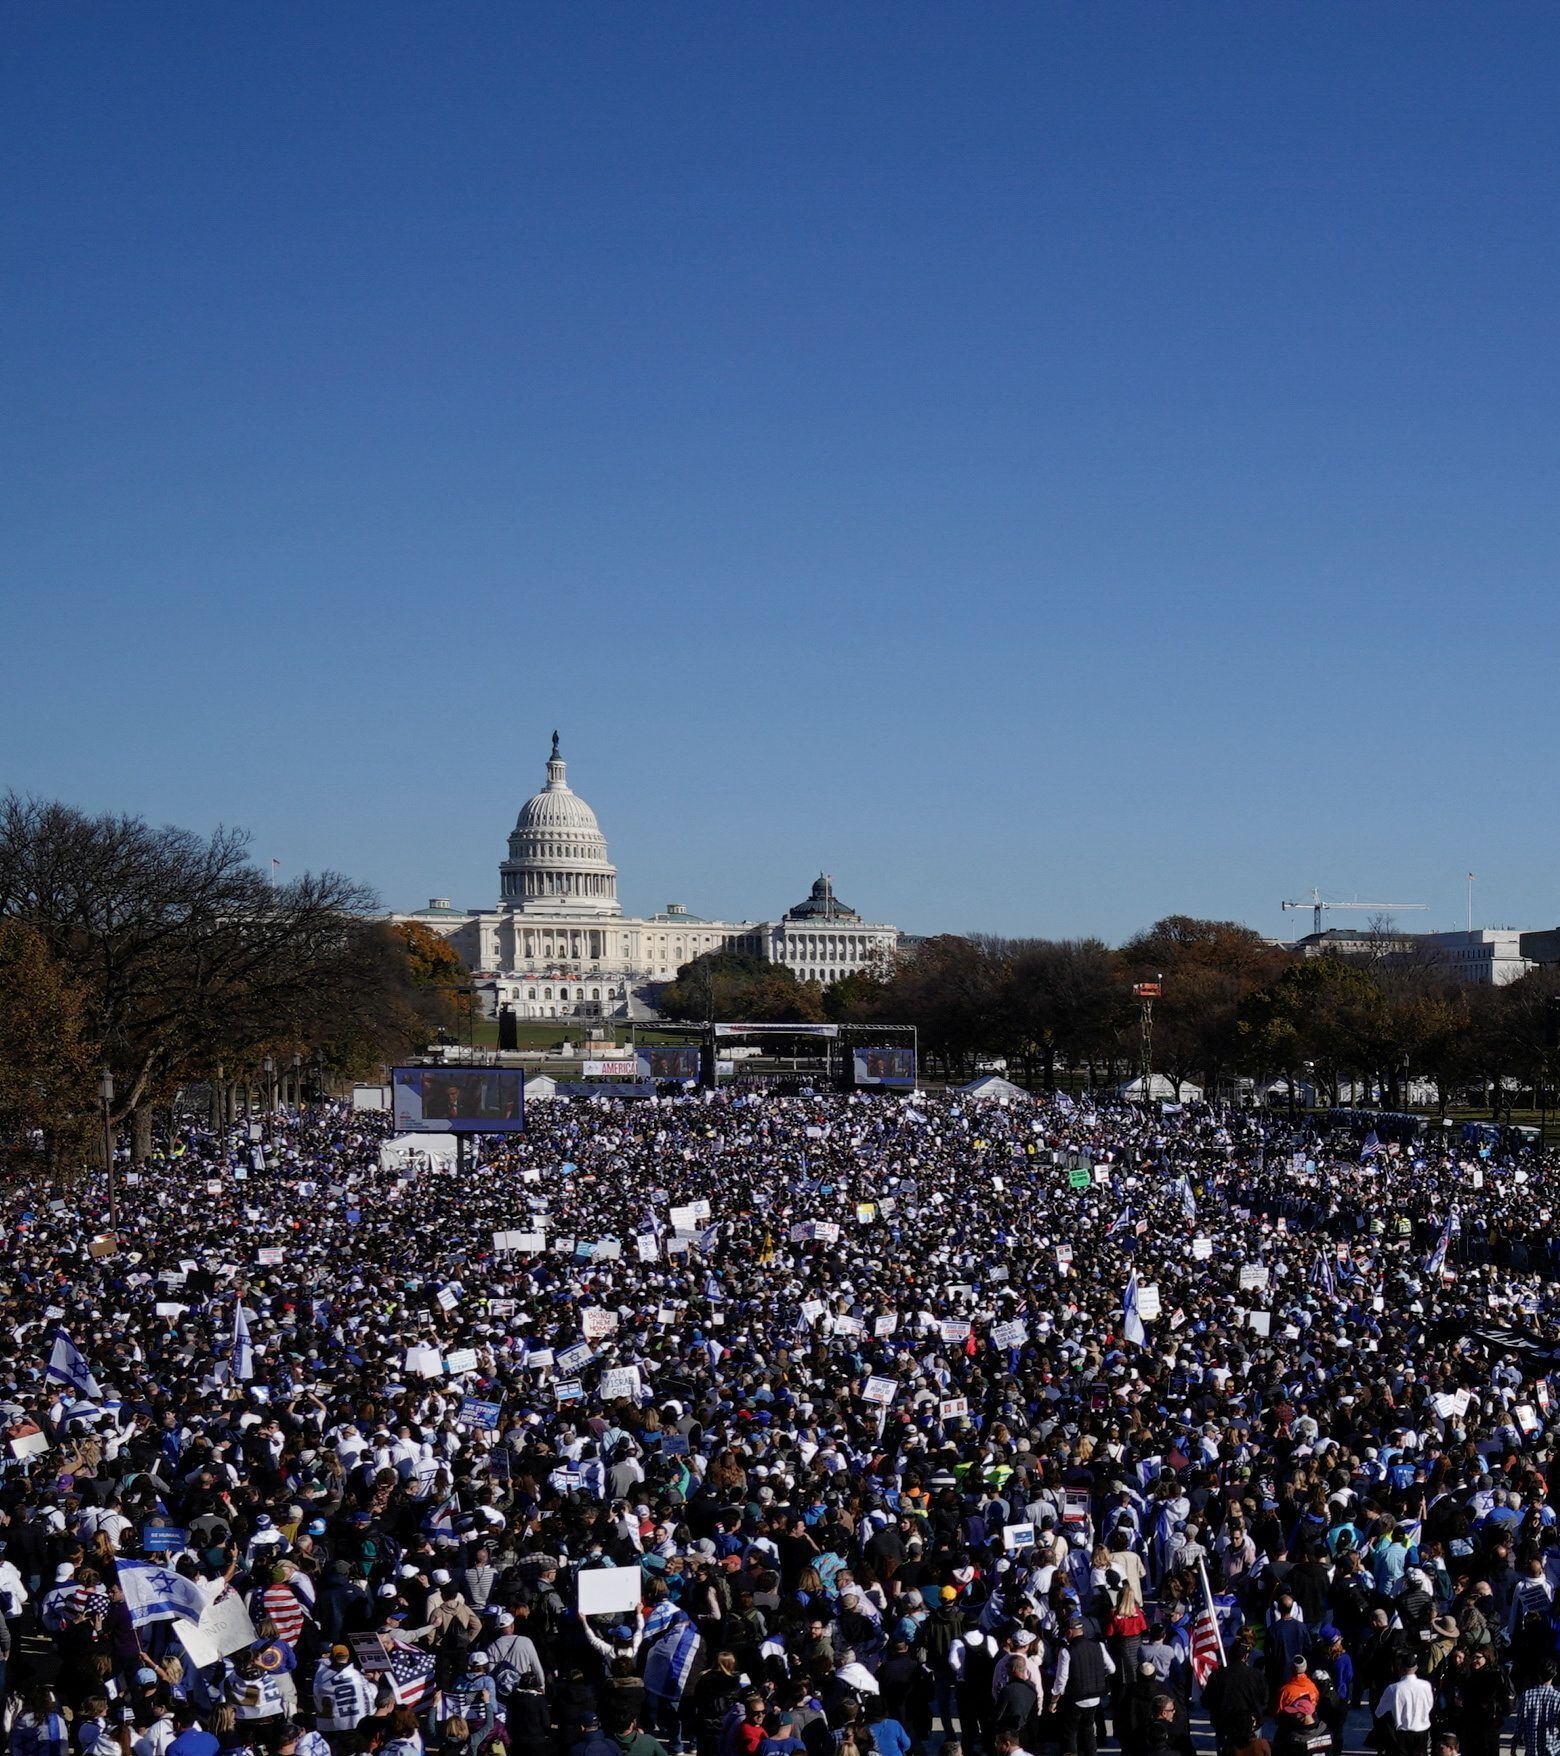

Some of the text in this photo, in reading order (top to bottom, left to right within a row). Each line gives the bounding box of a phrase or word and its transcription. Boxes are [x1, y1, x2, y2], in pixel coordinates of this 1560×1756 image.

[588, 1311, 612, 1320] BRING
[464, 1402, 498, 1415] WE STAND
[330, 1674, 360, 1718] FIDF
